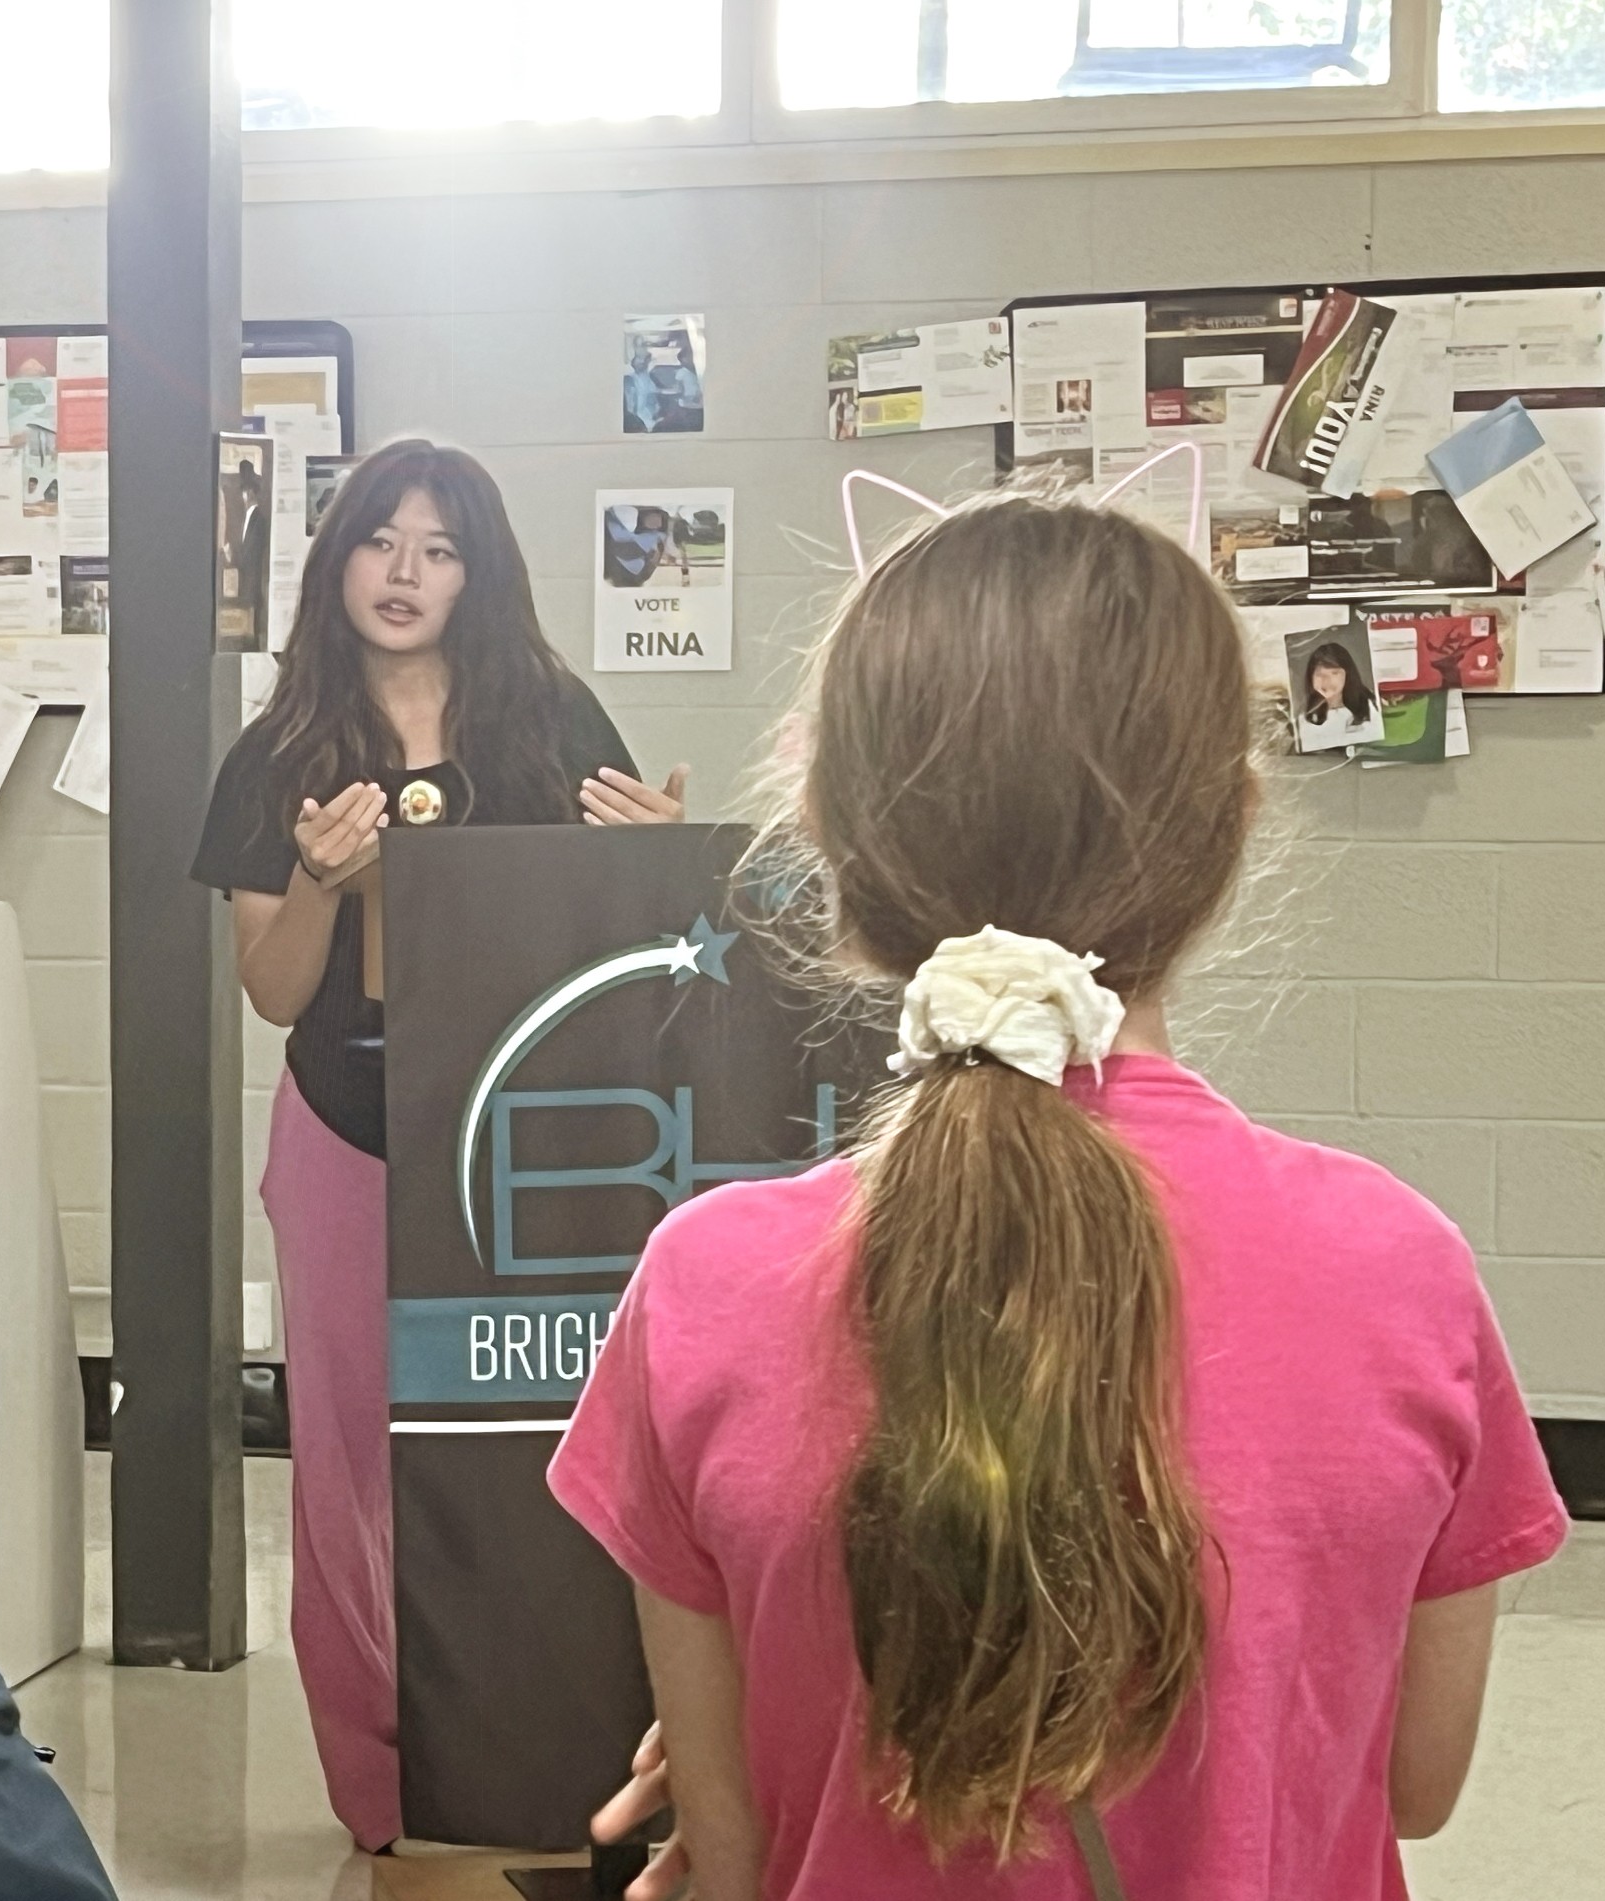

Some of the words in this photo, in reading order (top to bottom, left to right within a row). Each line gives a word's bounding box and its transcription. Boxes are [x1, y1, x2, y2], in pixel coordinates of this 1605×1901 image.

[1298, 400, 1358, 475] YOU!
[634, 597, 681, 613] VOTE
[625, 631, 705, 657] RINA
